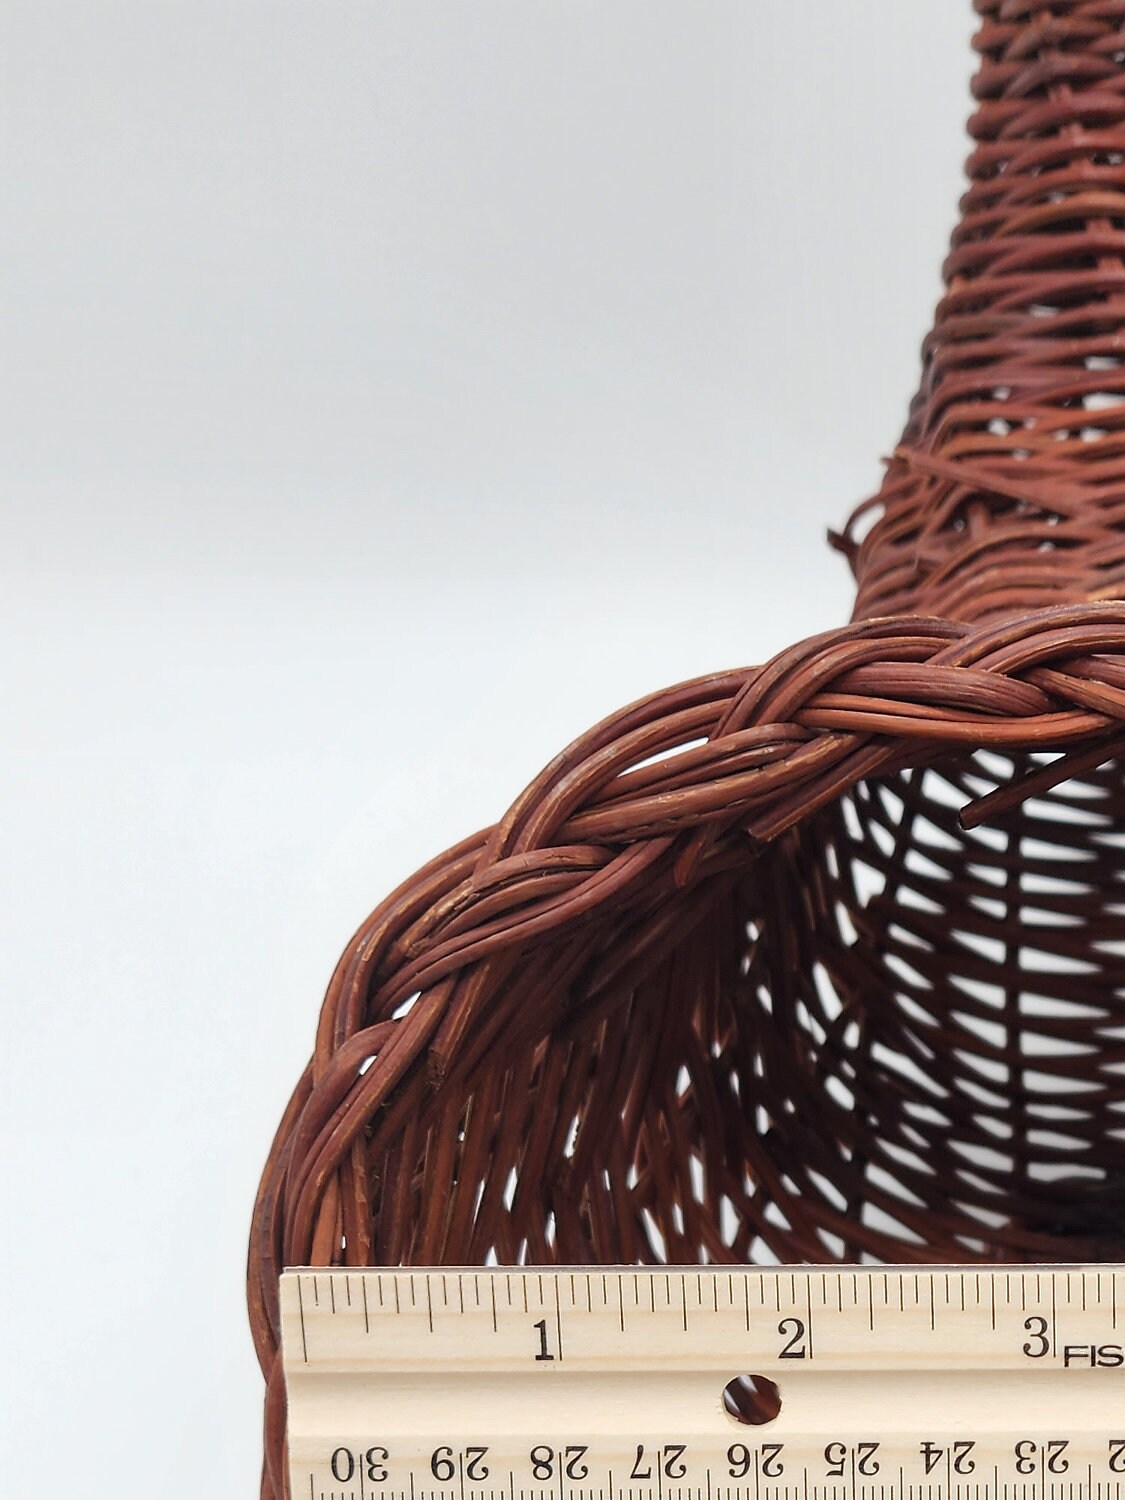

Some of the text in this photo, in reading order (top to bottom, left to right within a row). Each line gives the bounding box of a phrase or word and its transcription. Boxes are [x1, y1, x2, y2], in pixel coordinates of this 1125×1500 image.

[533, 1320, 554, 1361] 1
[778, 1318, 805, 1359] 2
[1022, 1317, 1050, 1358] 3
[330, 1447, 389, 1482] 30
[430, 1447, 489, 1481] 29
[530, 1446, 588, 1480] 28
[630, 1444, 687, 1479] 27
[727, 1444, 784, 1478] 26
[824, 1442, 880, 1477] 25
[920, 1441, 975, 1475] 24
[1014, 1440, 1068, 1473] 23
